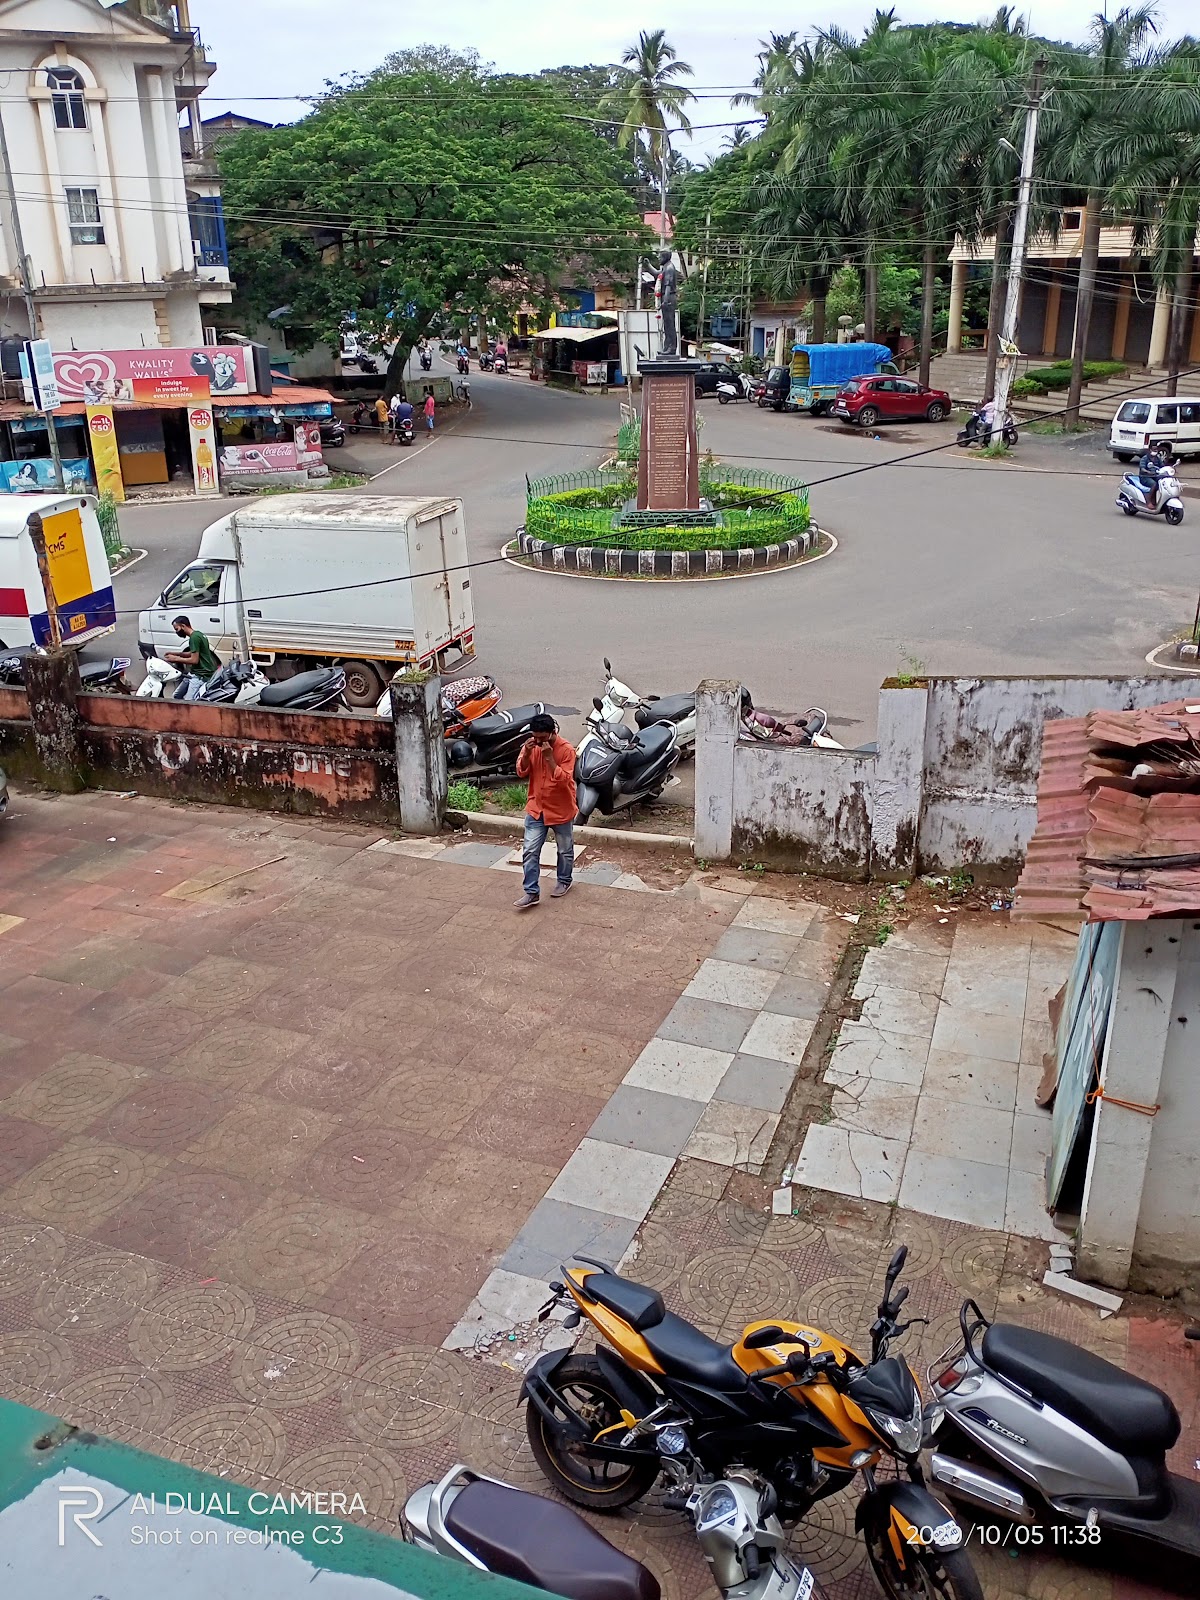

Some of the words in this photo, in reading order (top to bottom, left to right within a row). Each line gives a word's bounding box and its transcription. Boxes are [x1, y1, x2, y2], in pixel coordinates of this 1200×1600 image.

[129, 360, 174, 369] KWALITY
[48, 540, 65, 554] CMS
[986, 1418, 1029, 1445] Access
